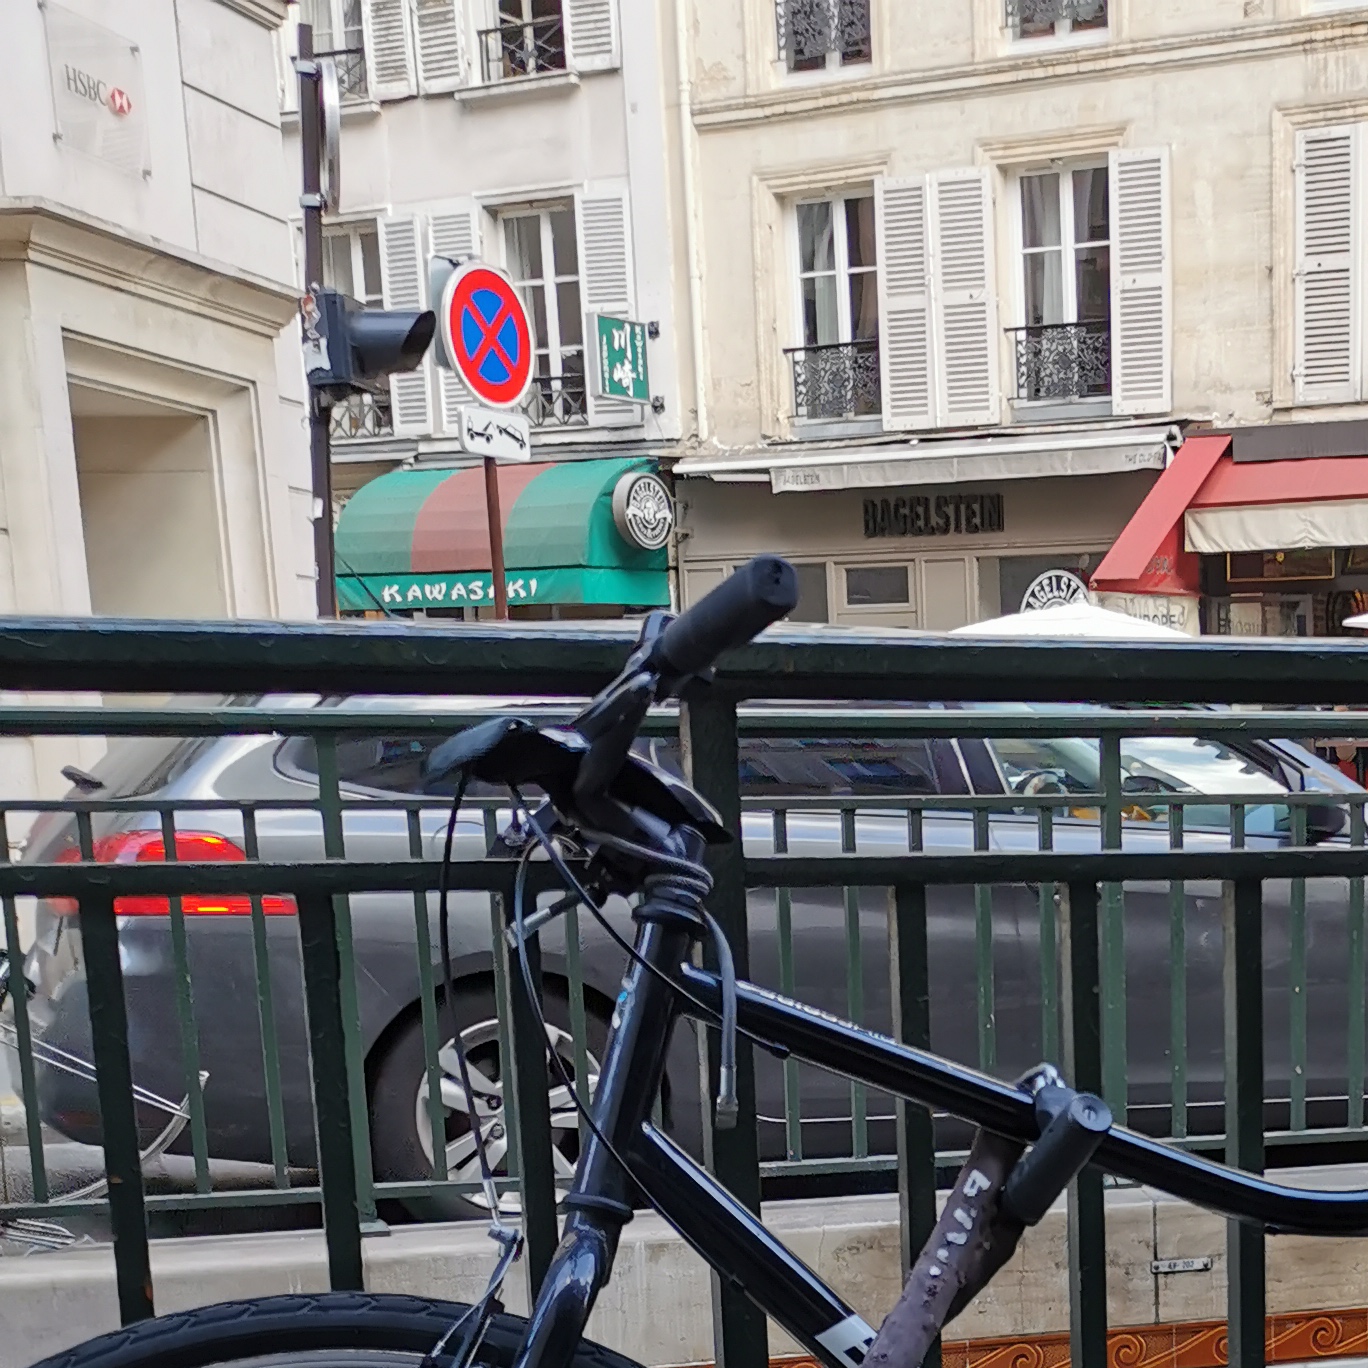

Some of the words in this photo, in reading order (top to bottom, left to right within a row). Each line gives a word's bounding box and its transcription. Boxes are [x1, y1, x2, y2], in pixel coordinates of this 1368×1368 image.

[64, 64, 107, 106] HSBC
[612, 322, 637, 397] 川崎
[862, 493, 1004, 537] BAGELSTEIN
